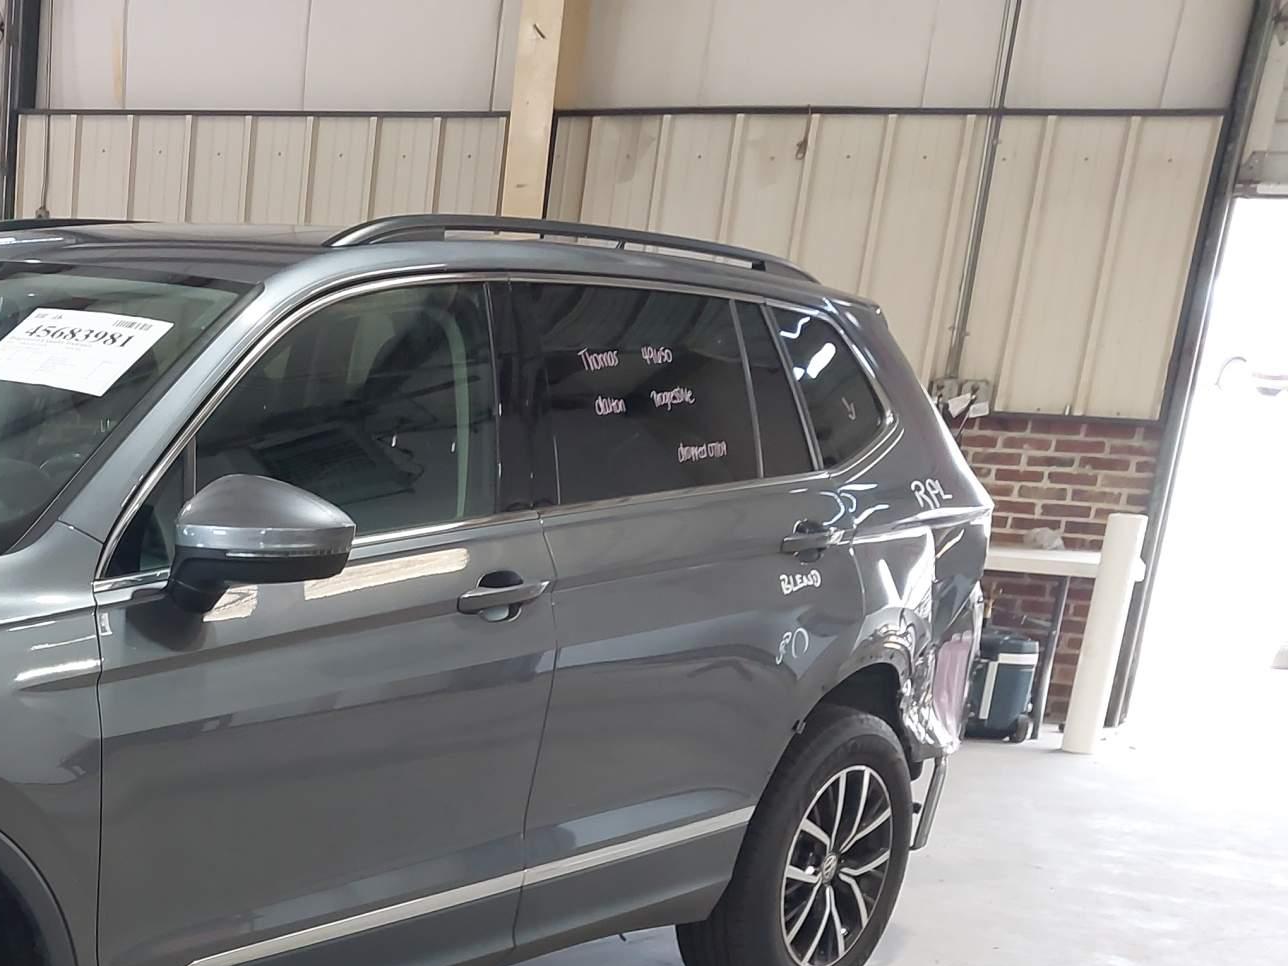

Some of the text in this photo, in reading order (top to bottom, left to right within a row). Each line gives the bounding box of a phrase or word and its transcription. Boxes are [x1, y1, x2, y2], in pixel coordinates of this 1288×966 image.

[25, 324, 135, 348] 45683981
[577, 347, 619, 371] Thomas
[779, 569, 821, 595] BLEND
